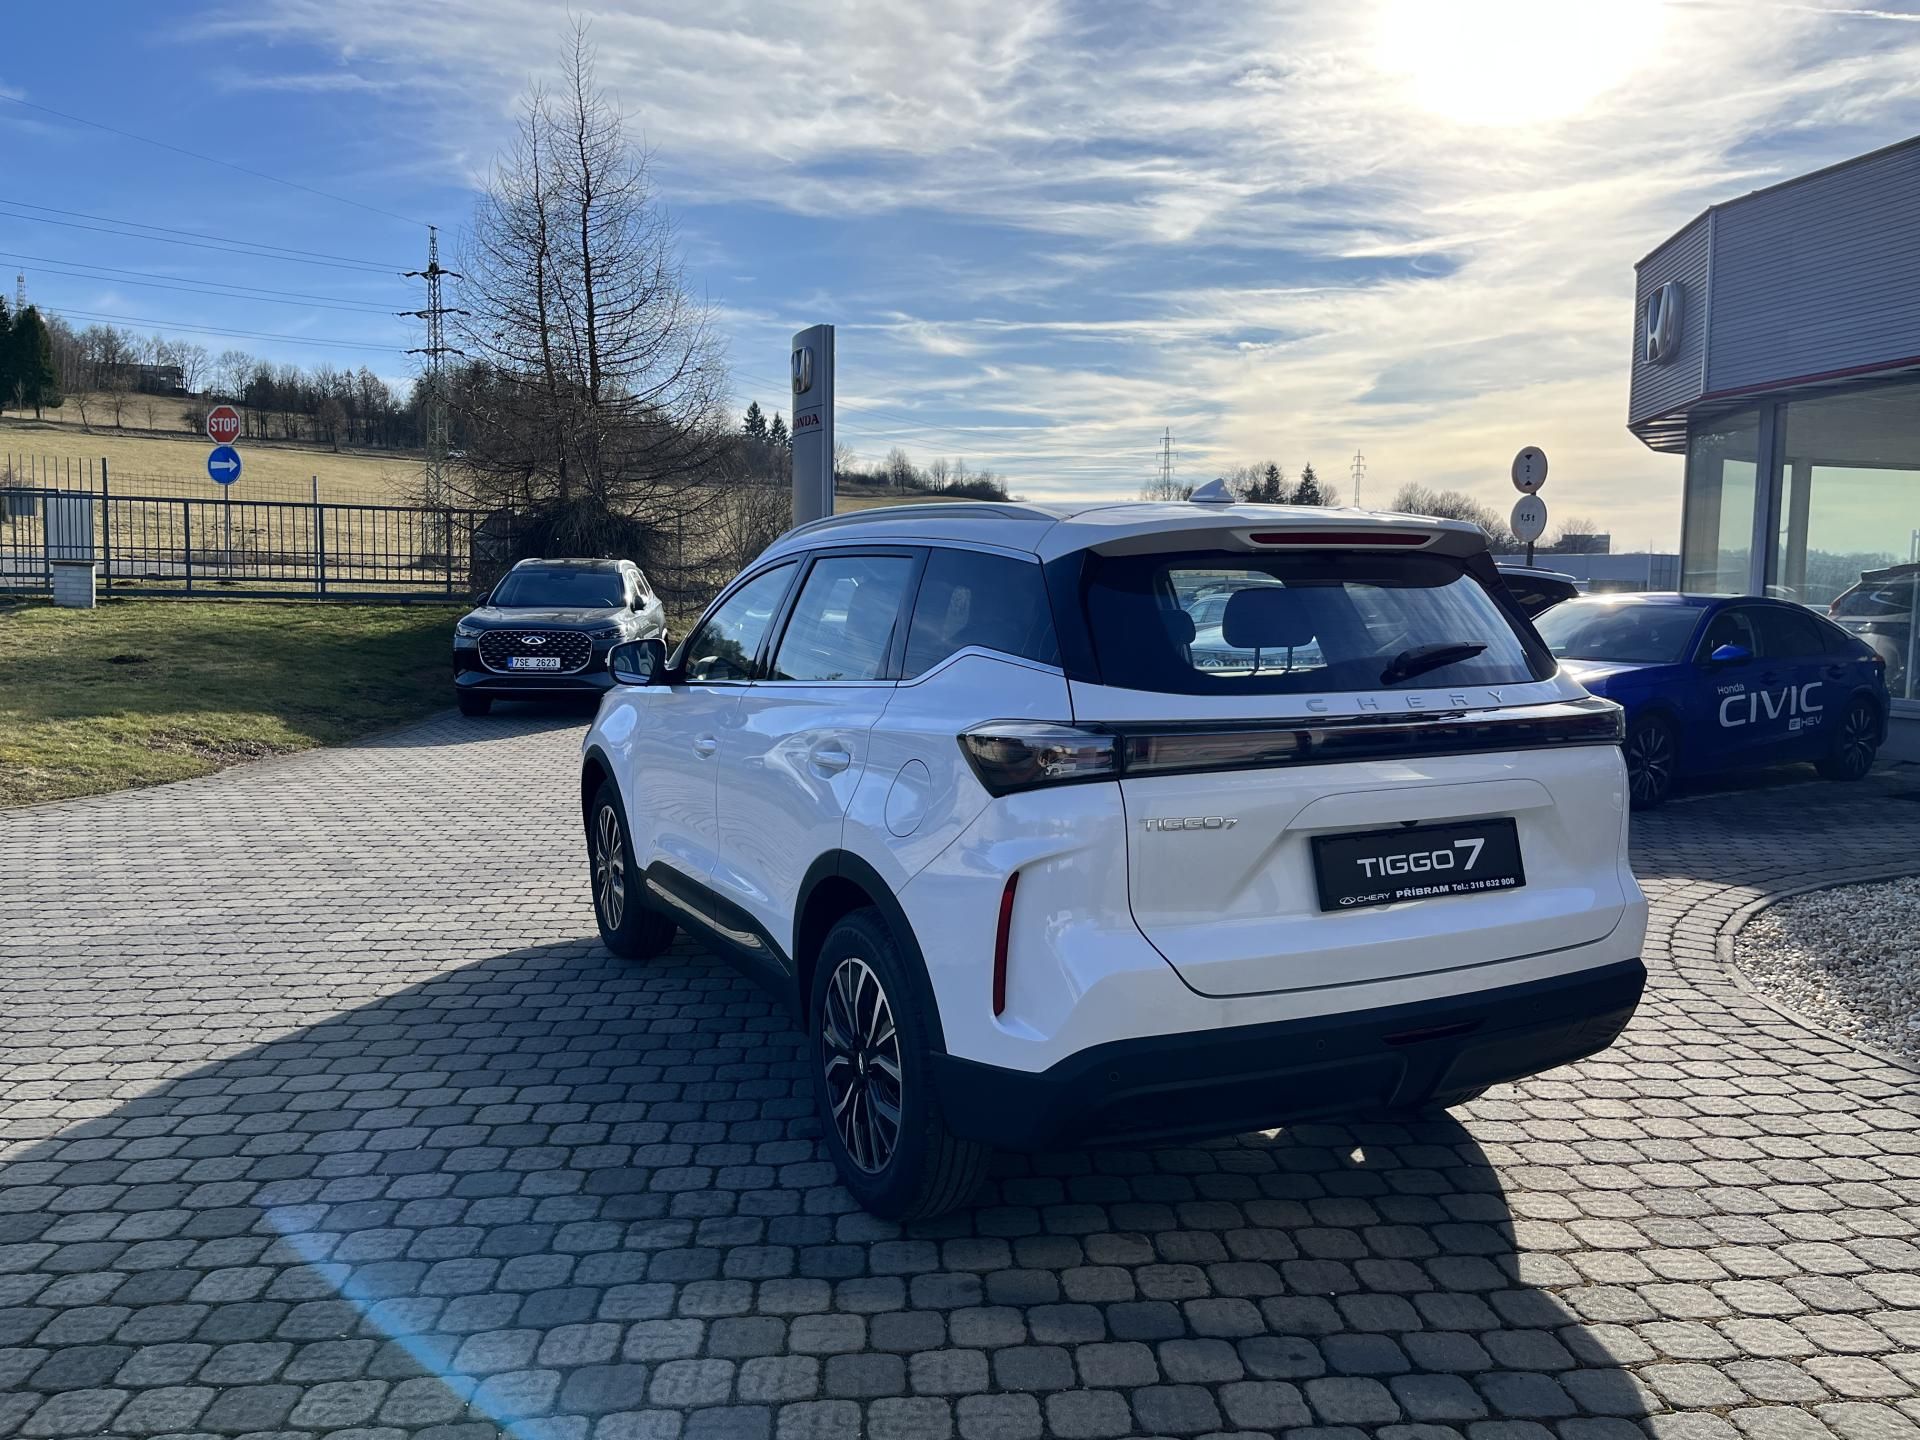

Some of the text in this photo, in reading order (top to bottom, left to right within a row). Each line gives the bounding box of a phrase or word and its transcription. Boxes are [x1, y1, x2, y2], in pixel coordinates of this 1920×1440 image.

[210, 417, 238, 432] STOP
[515, 658, 530, 666] 7SE
[536, 658, 556, 666] 2623
[1717, 683, 1745, 695] Honda
[1306, 690, 1503, 713] CHERY
[1720, 682, 1823, 727] CIVIC
[1356, 838, 1485, 878] TIGGO 7
[1356, 877, 1516, 903] CHERY PŘÍBRAM Tel.: 318 632 906
